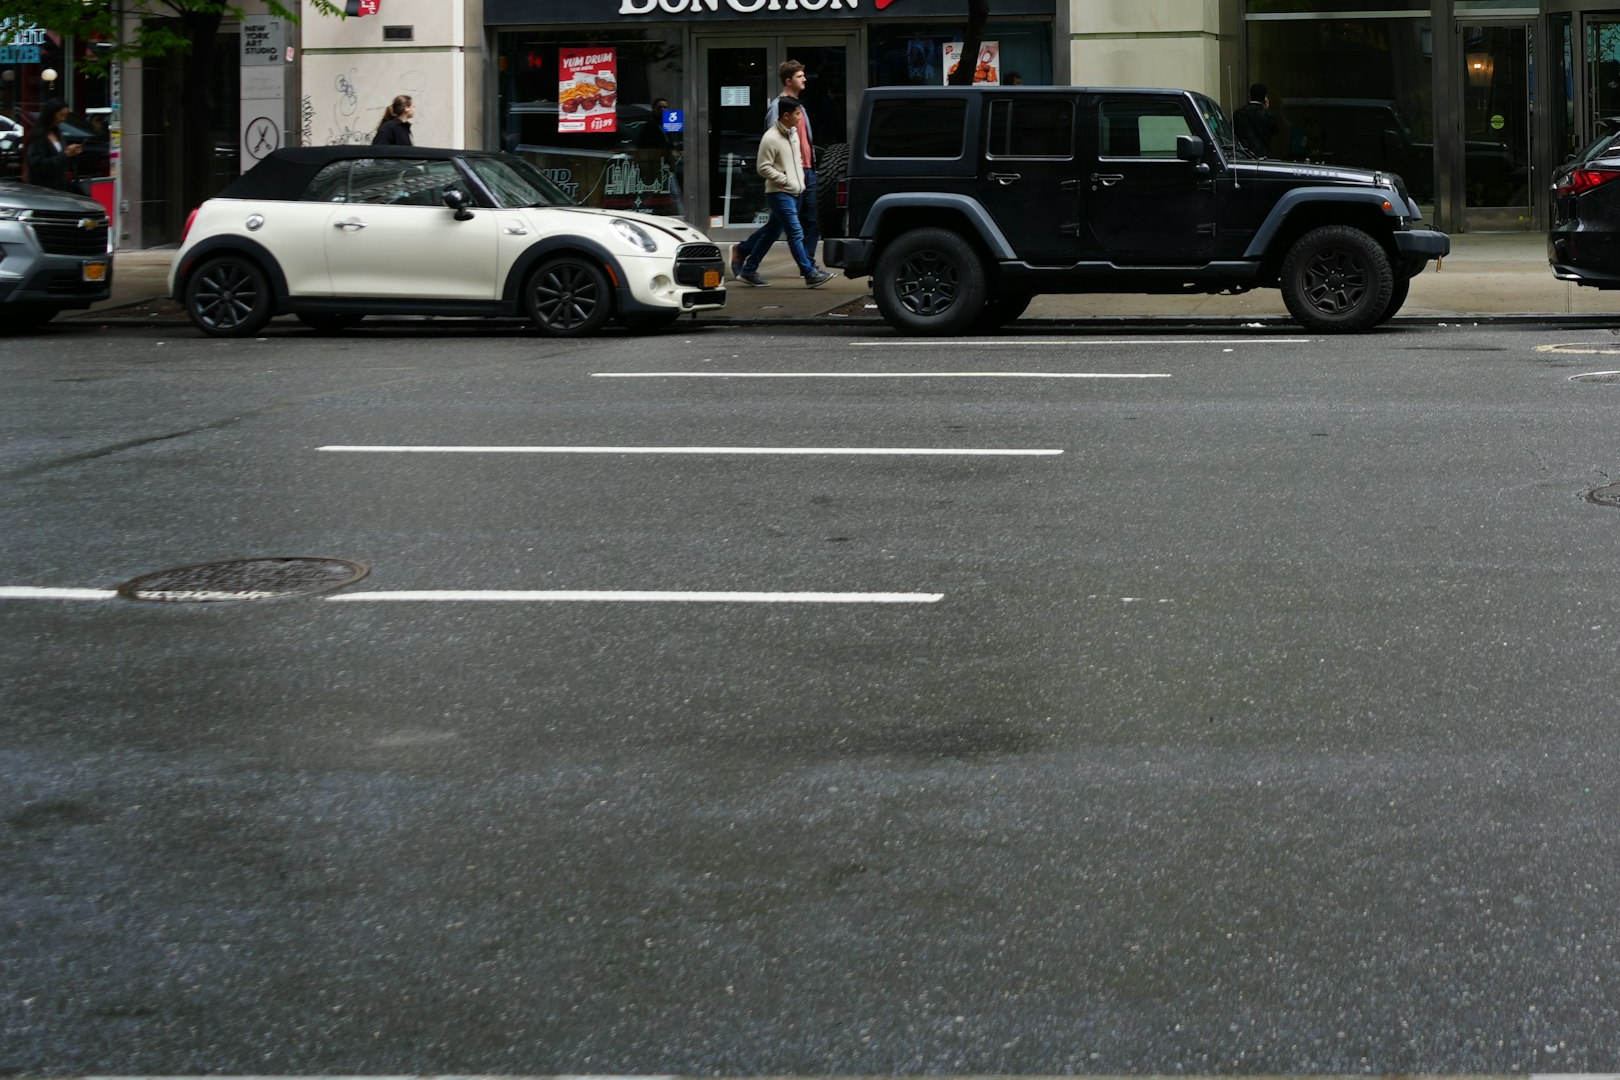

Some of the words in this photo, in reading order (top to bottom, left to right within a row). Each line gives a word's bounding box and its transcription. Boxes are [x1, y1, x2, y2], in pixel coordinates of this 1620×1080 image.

[244, 39, 262, 47] ART
[563, 56, 584, 68] YUM
[585, 52, 613, 65] DRUM
